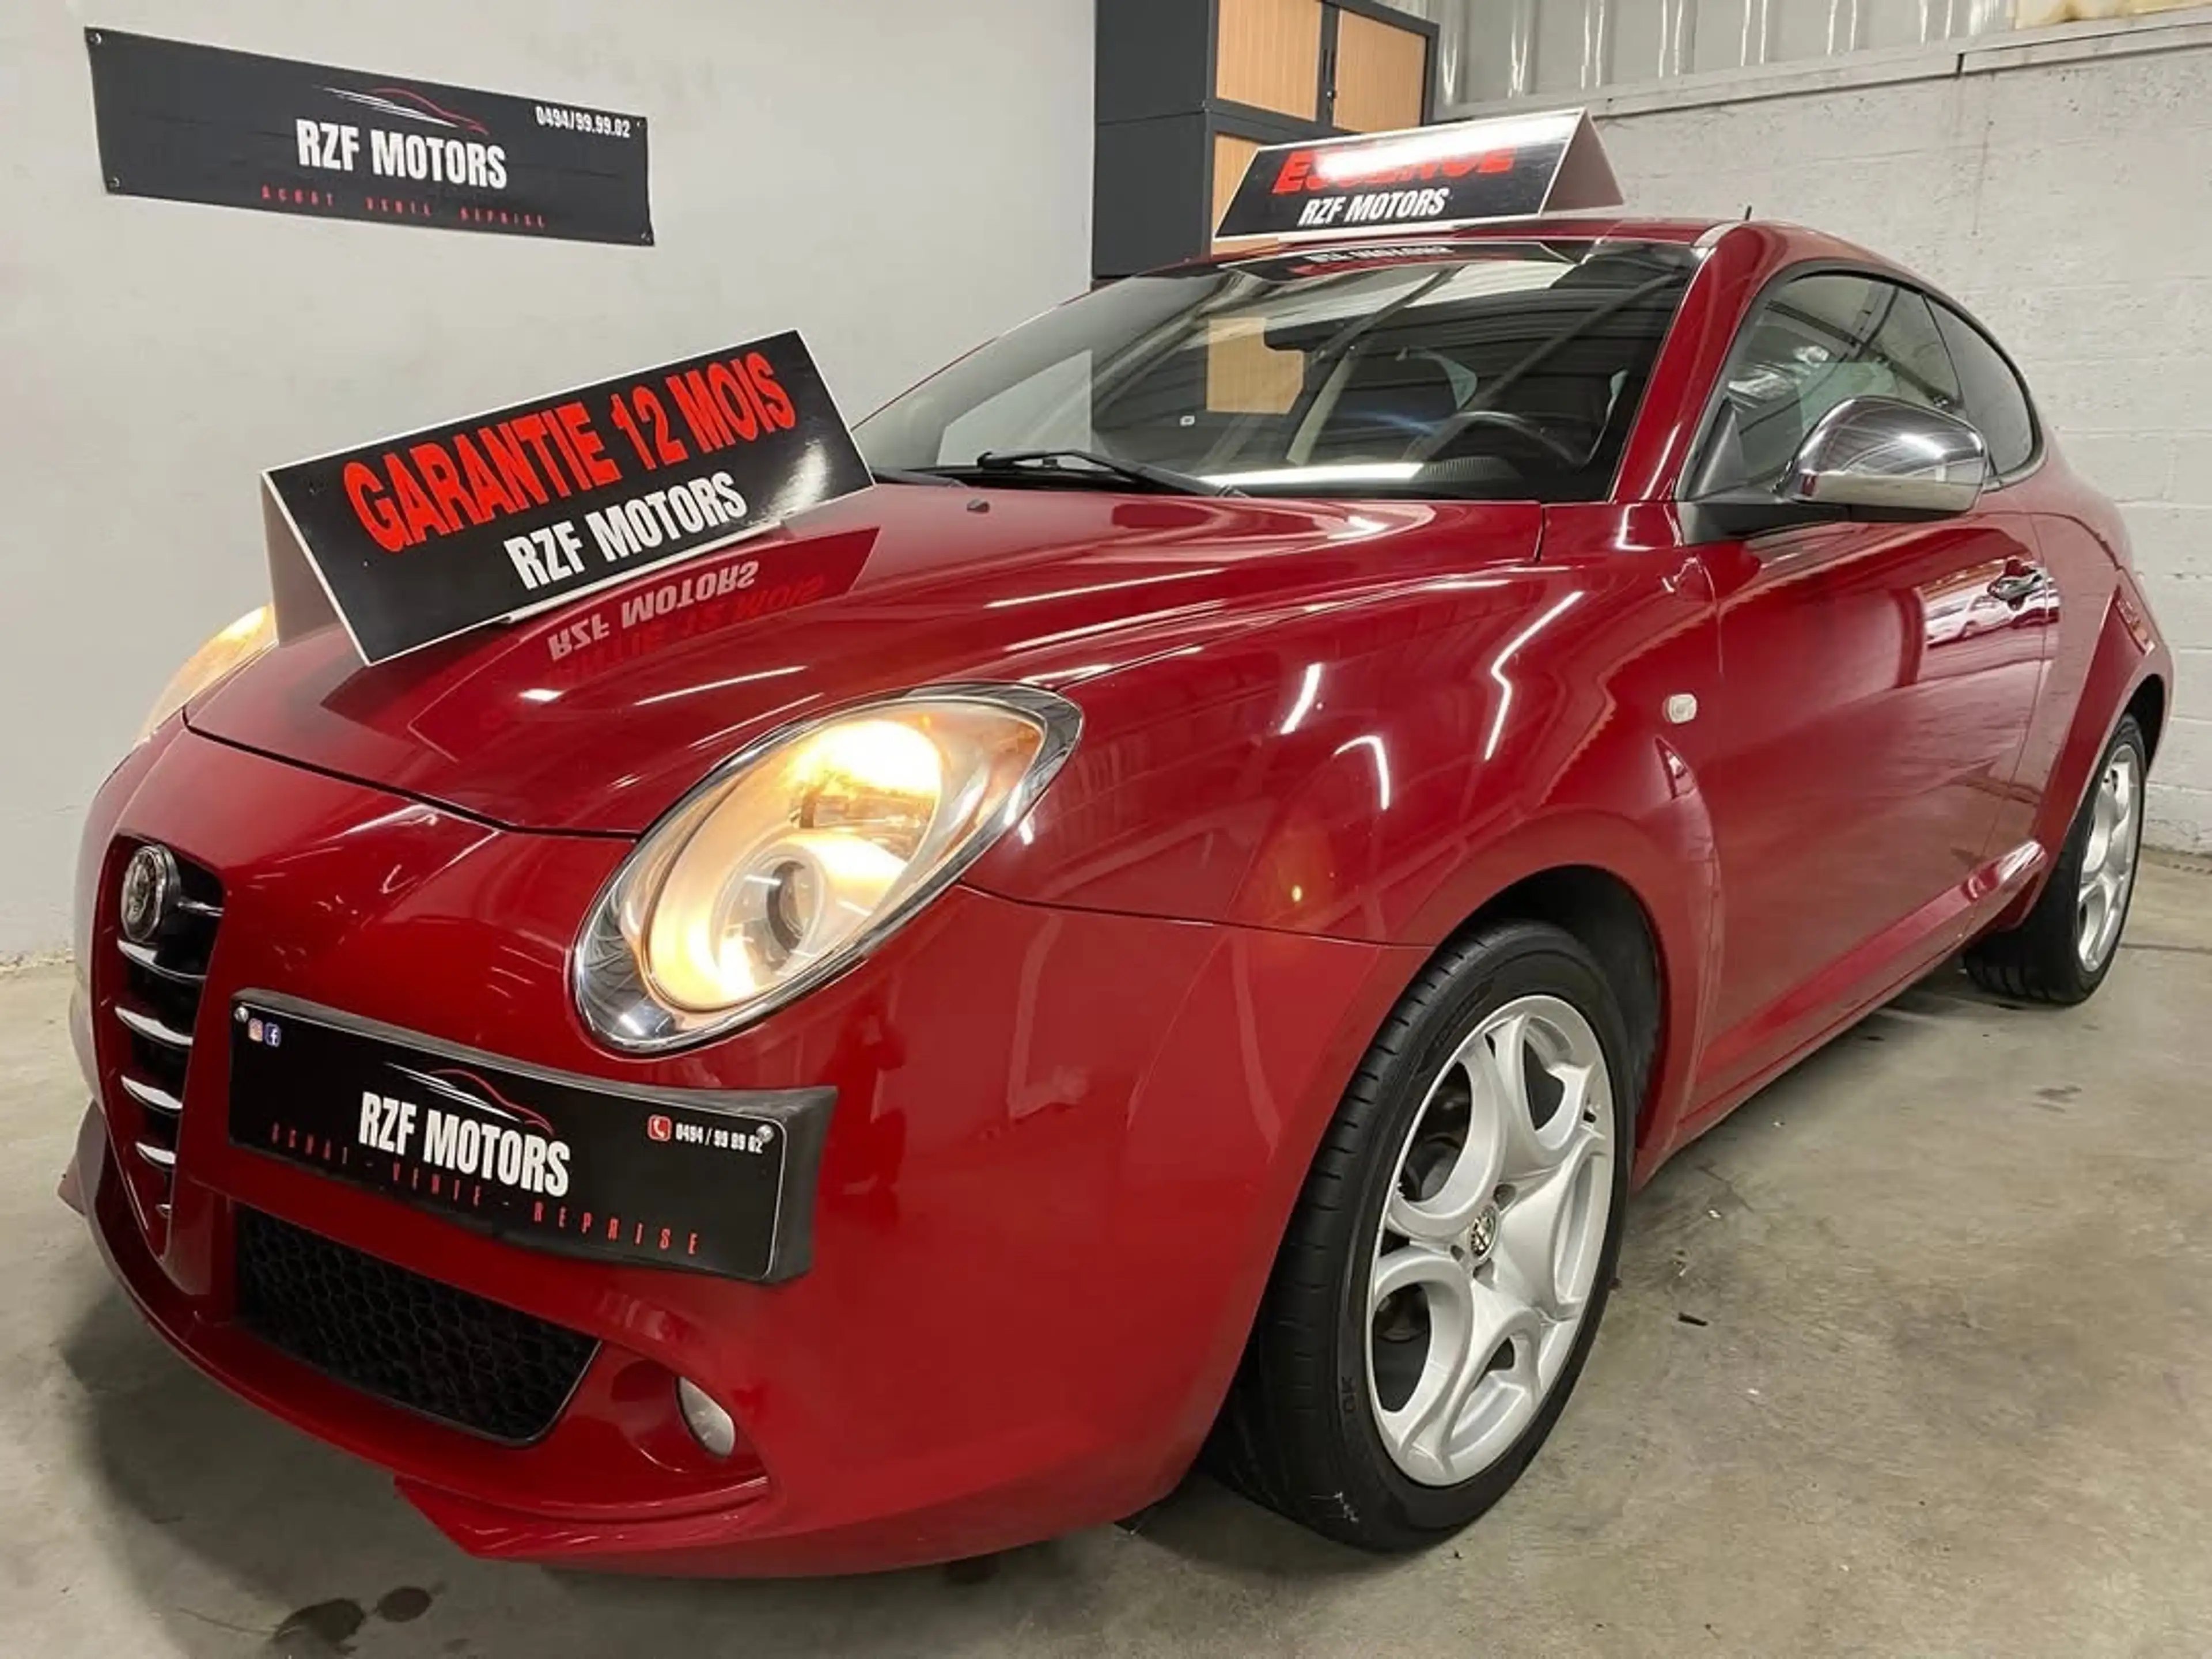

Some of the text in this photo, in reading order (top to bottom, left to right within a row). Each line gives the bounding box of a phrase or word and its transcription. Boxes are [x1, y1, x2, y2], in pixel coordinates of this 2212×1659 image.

[296, 118, 507, 190] RZF MOTORS
[1297, 187, 1450, 227] RZF MOTORS
[344, 351, 796, 552] GARANTIE 12 MOIS
[503, 471, 748, 590] RZF MOTORS
[358, 1090, 570, 1197] RZF MOTORS
[534, 1201, 698, 1255] REPRISE
